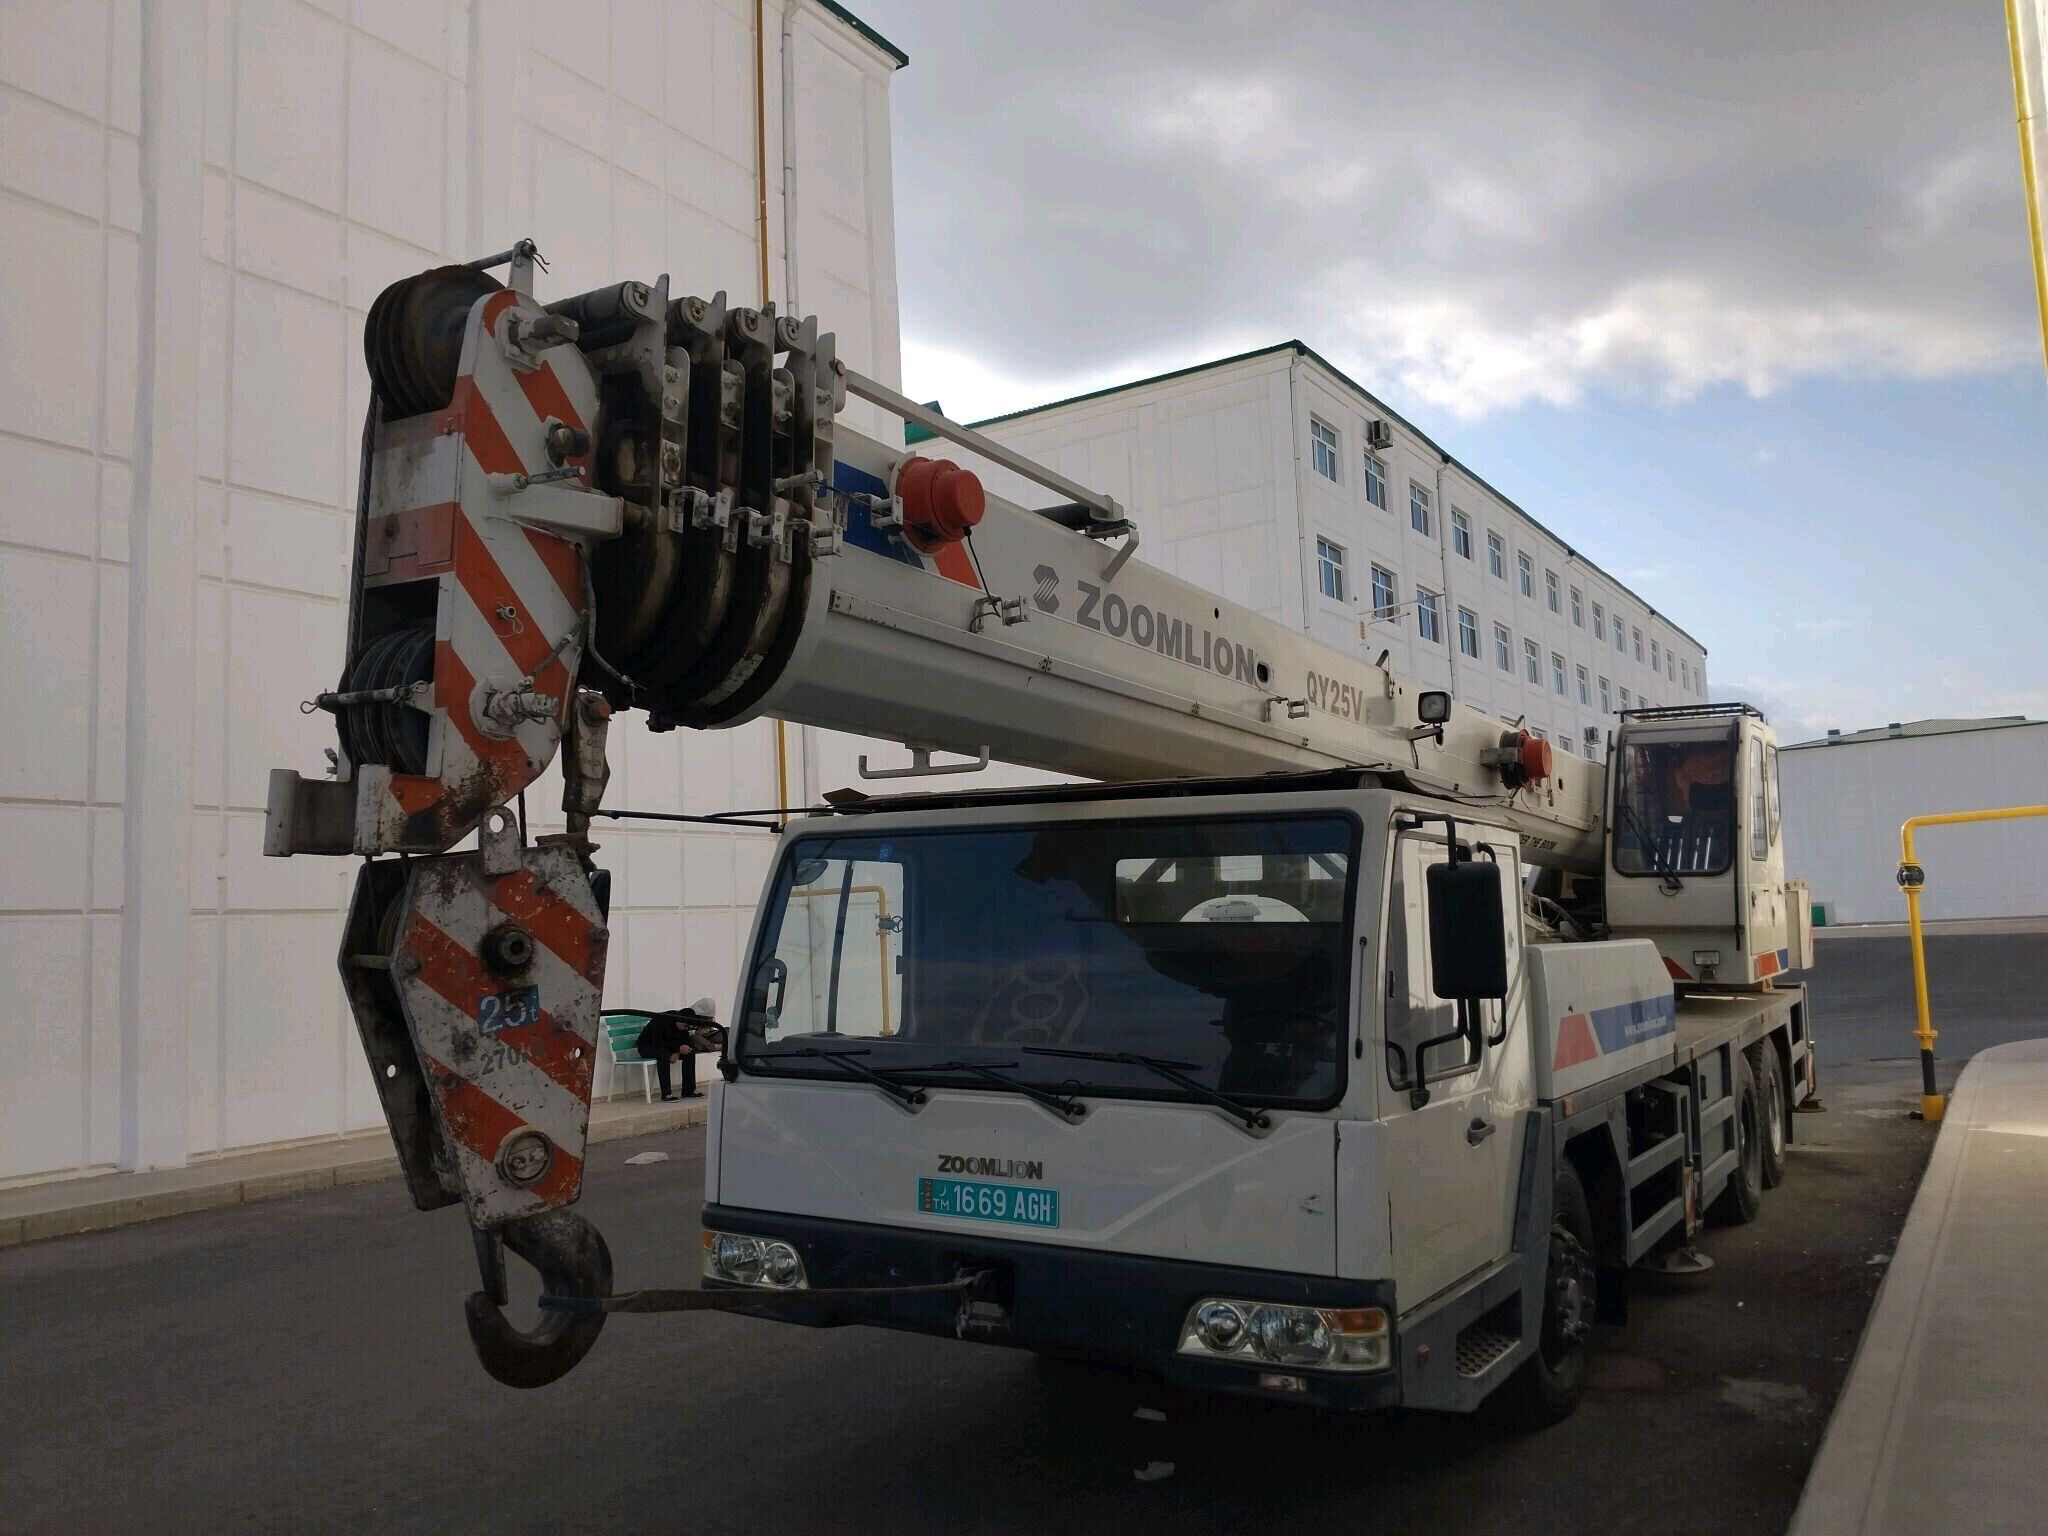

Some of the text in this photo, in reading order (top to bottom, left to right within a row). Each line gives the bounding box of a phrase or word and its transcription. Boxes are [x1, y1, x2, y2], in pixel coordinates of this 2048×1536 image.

[1077, 580, 1255, 686] ZOOMLION
[937, 1154, 1043, 1180] ZOOMLION
[932, 1184, 1051, 1223] TM 1669 AGH
